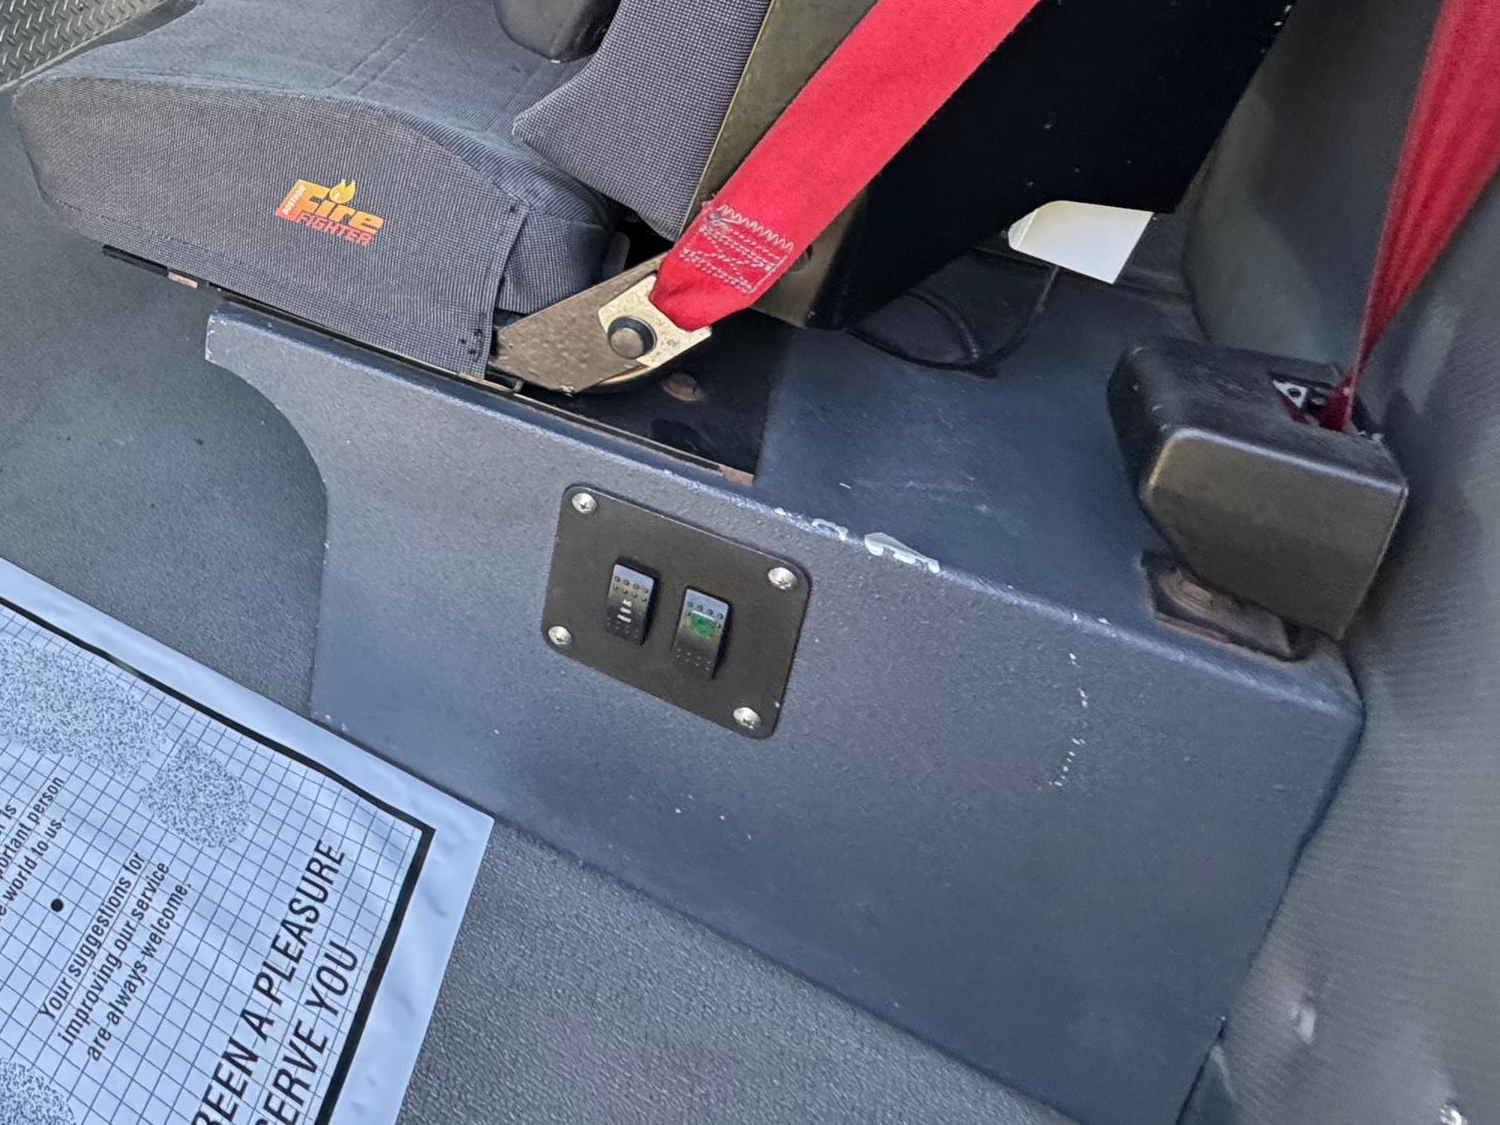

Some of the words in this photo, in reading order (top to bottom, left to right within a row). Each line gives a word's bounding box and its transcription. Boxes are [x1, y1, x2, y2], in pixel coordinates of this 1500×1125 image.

[295, 212, 373, 247] FIGHTER
[0, 804, 17, 821] is
[27, 777, 65, 825] person
[2, 855, 38, 902] world
[31, 840, 49, 858] to
[38, 976, 73, 1022] Your
[68, 877, 132, 978] suggestions
[123, 852, 146, 876] for
[57, 952, 123, 1046] improving
[114, 920, 137, 952] our
[131, 861, 170, 922] service
[252, 839, 346, 1007] PLEASURE
[87, 1028, 112, 1062] are
[106, 960, 148, 1026] always
[240, 1008, 275, 1043] A
[255, 1018, 329, 1125] ERVE
[304, 940, 359, 1017] YOU
